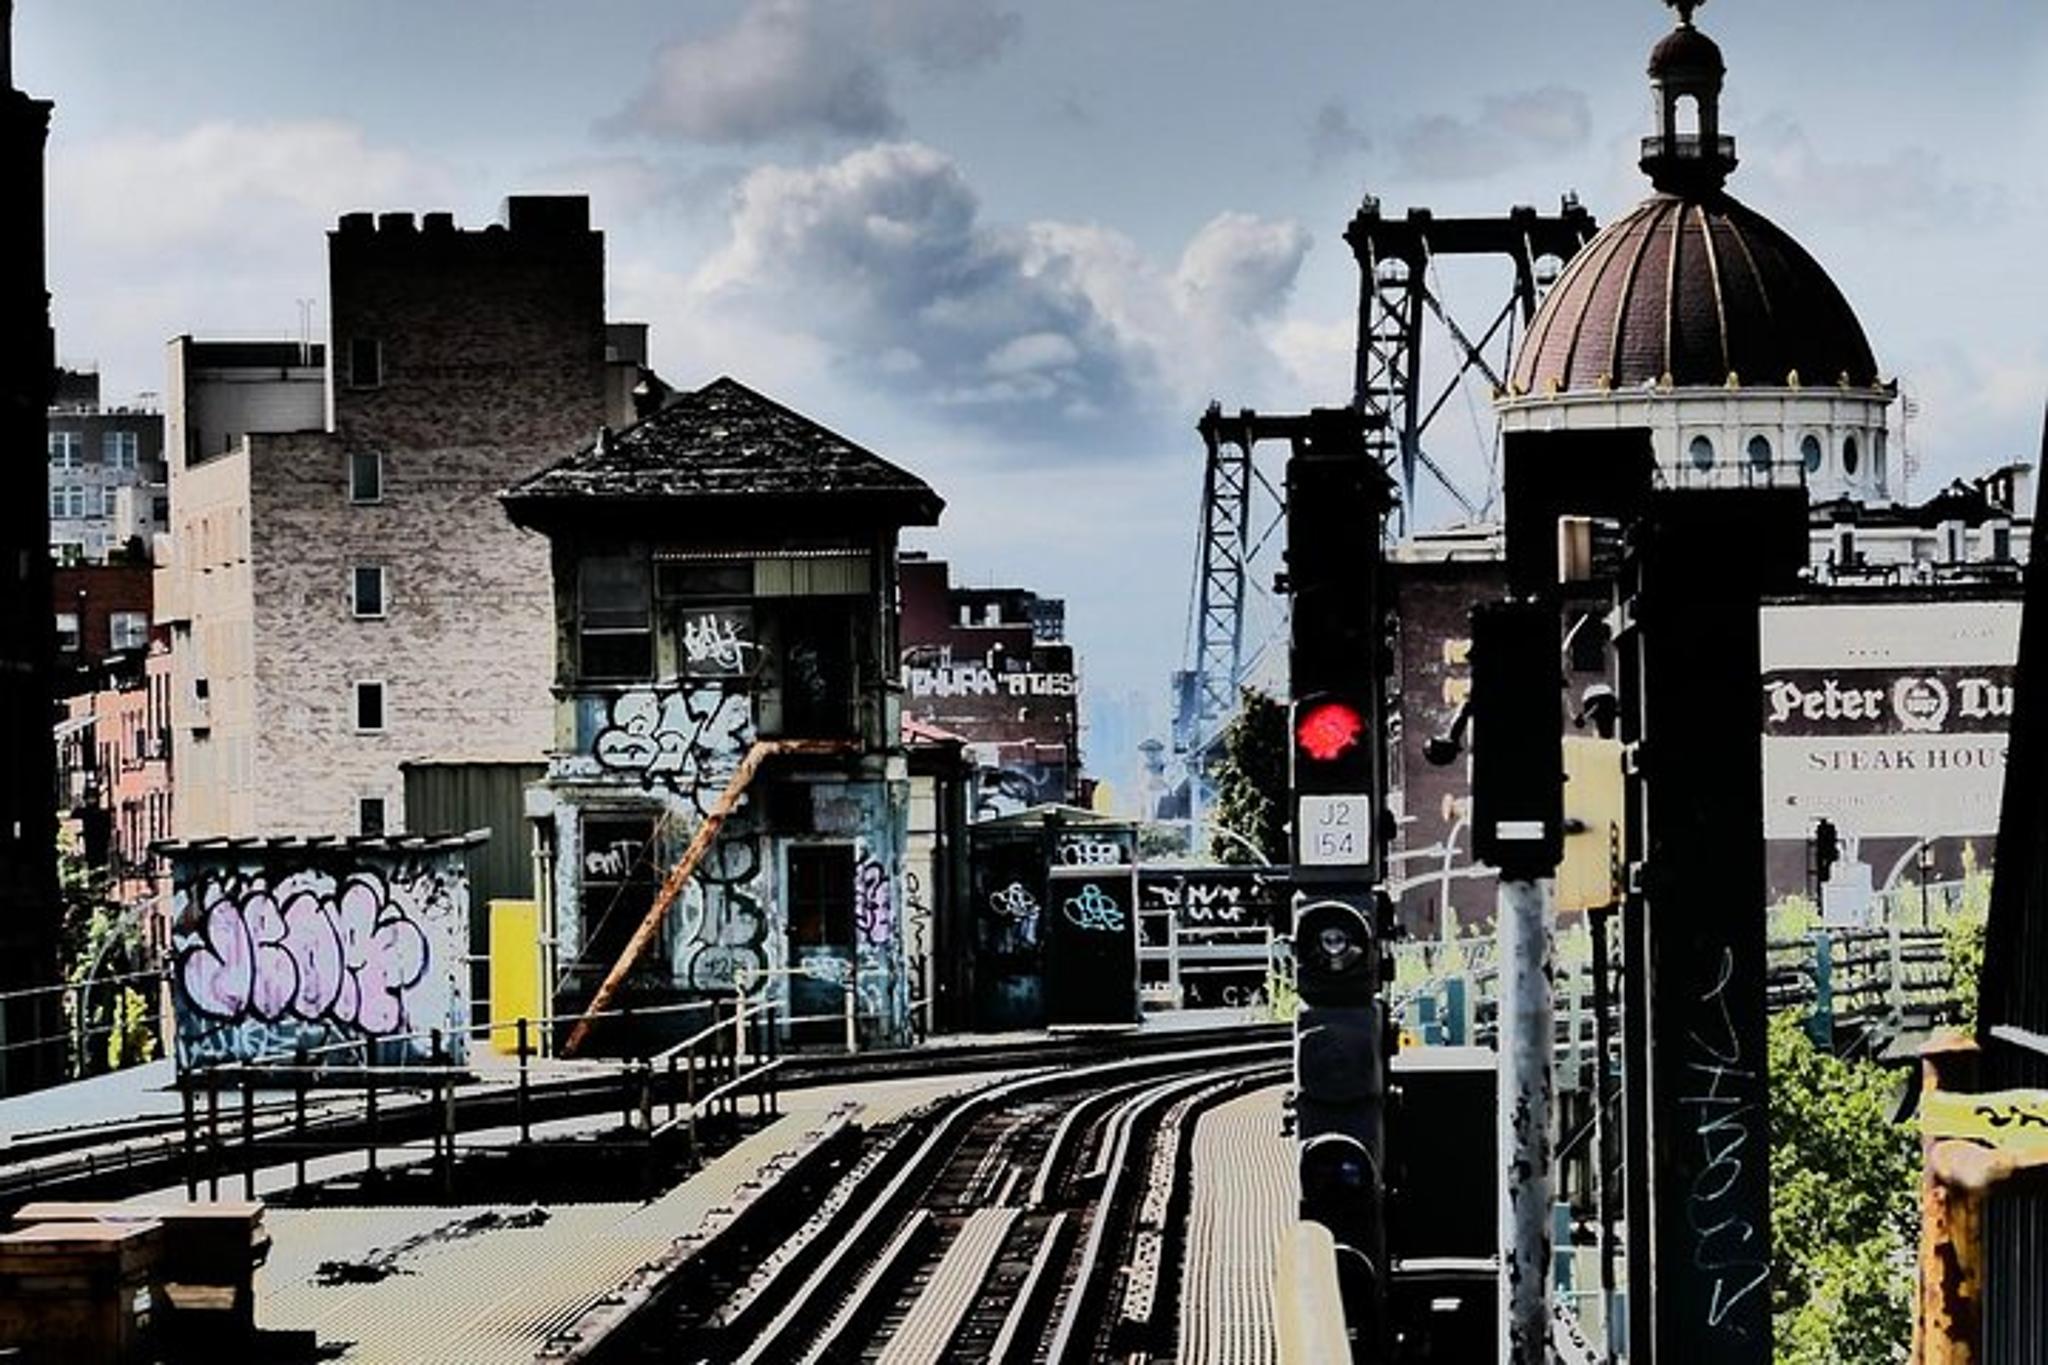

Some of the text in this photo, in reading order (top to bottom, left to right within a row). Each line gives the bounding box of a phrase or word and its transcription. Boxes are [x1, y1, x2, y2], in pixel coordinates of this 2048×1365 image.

[1763, 679, 1884, 722] Peter
[1808, 750, 1916, 770] STEAK
[1319, 802, 1350, 826] J2
